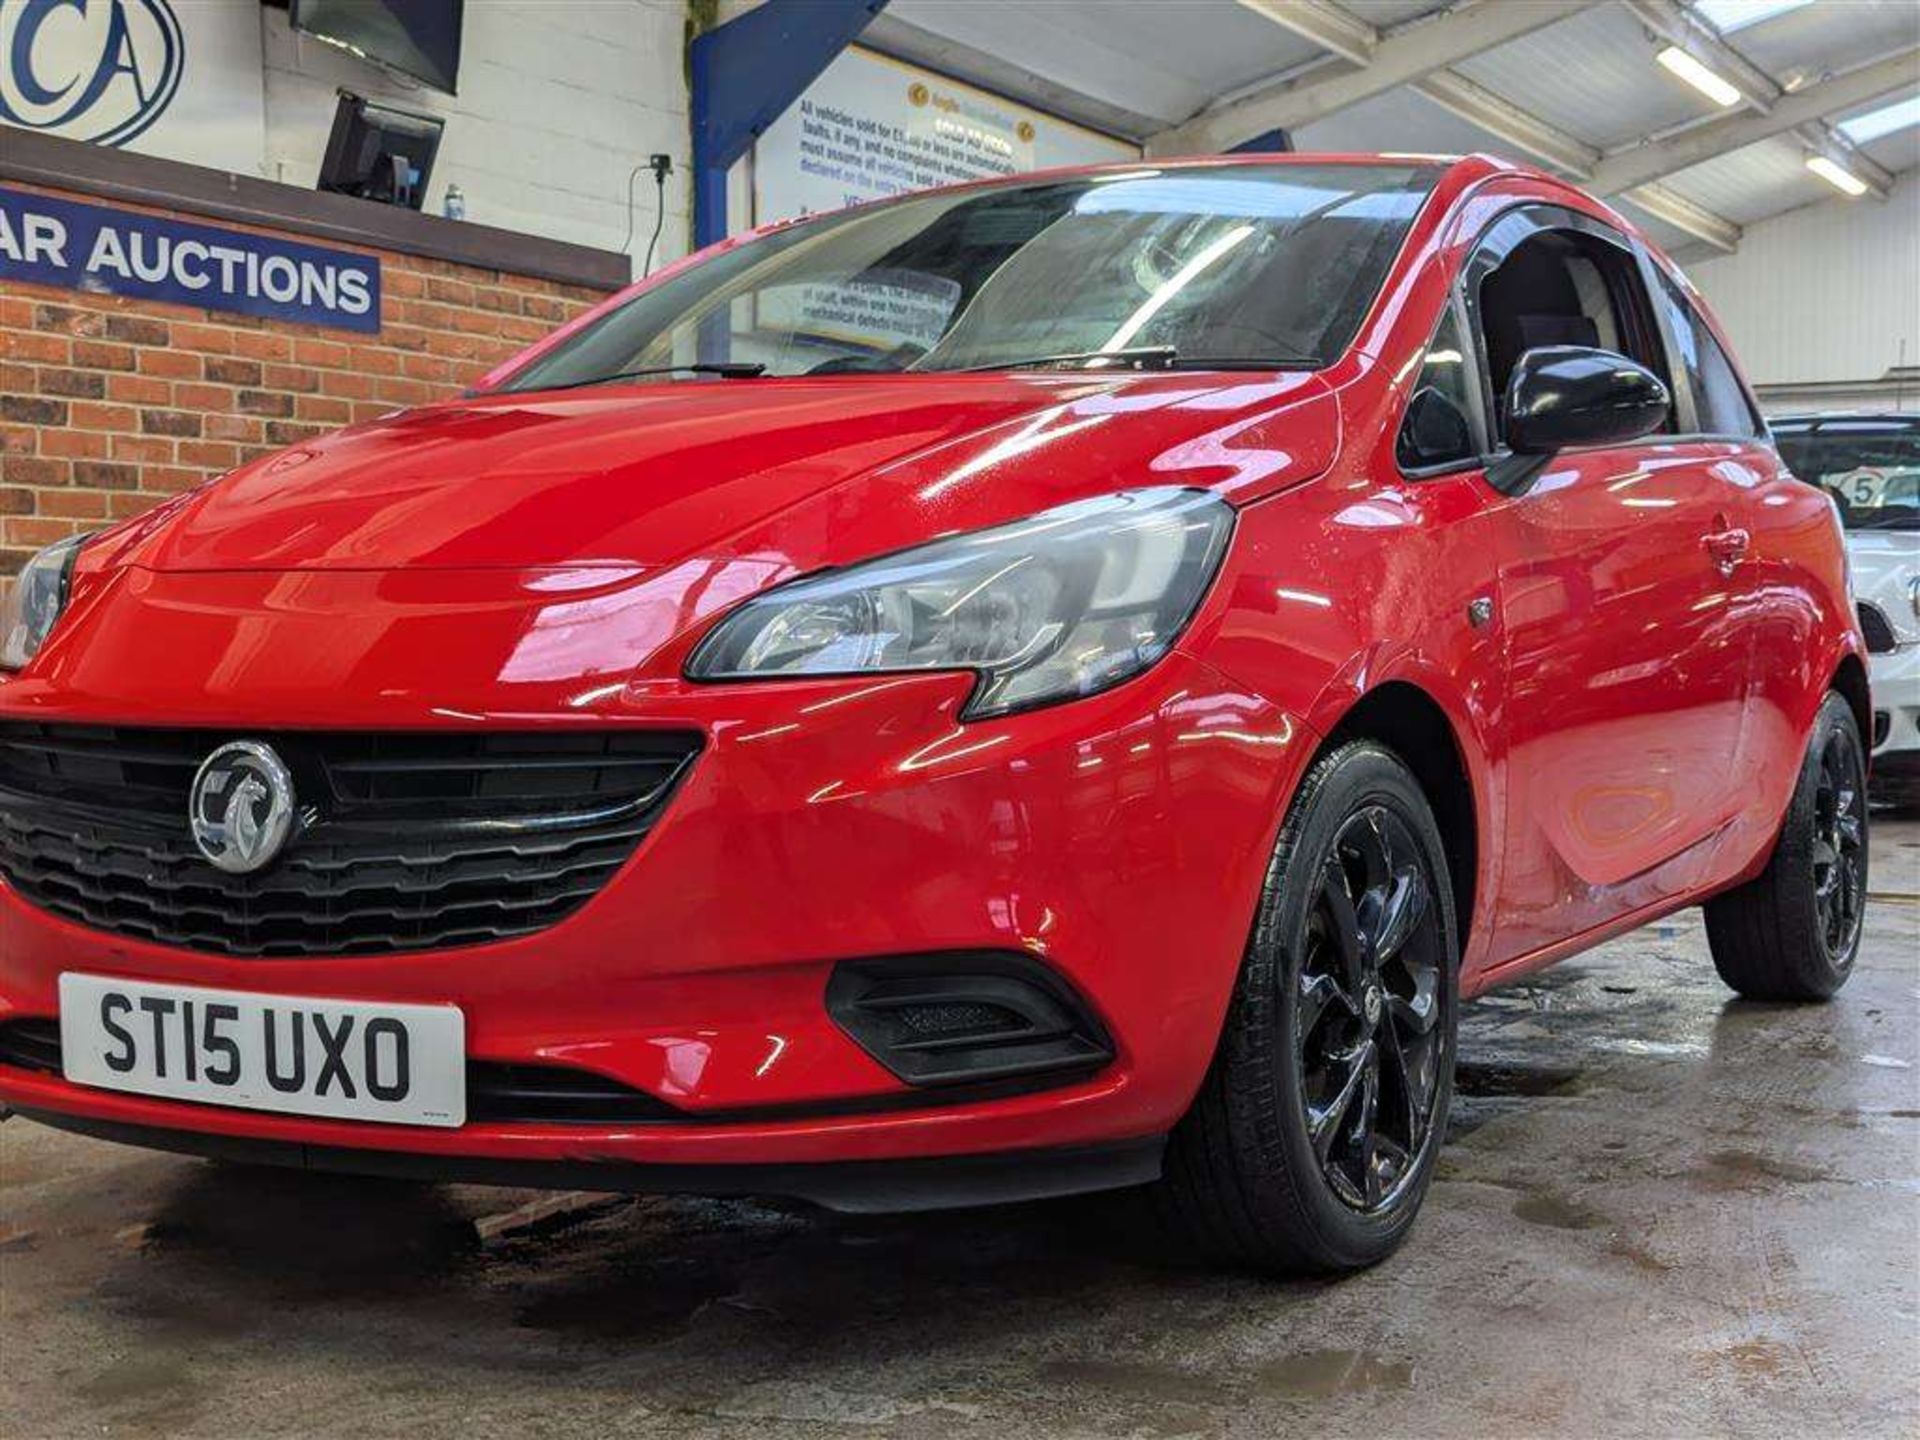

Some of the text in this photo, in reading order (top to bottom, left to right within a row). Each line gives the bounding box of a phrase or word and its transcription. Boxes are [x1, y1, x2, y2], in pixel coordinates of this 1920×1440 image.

[801, 99, 812, 115] All
[815, 105, 854, 128] vehicles
[86, 227, 371, 314] AUCTIONS
[1855, 478, 1873, 503] 5
[101, 993, 409, 1102] ST15 UXO
